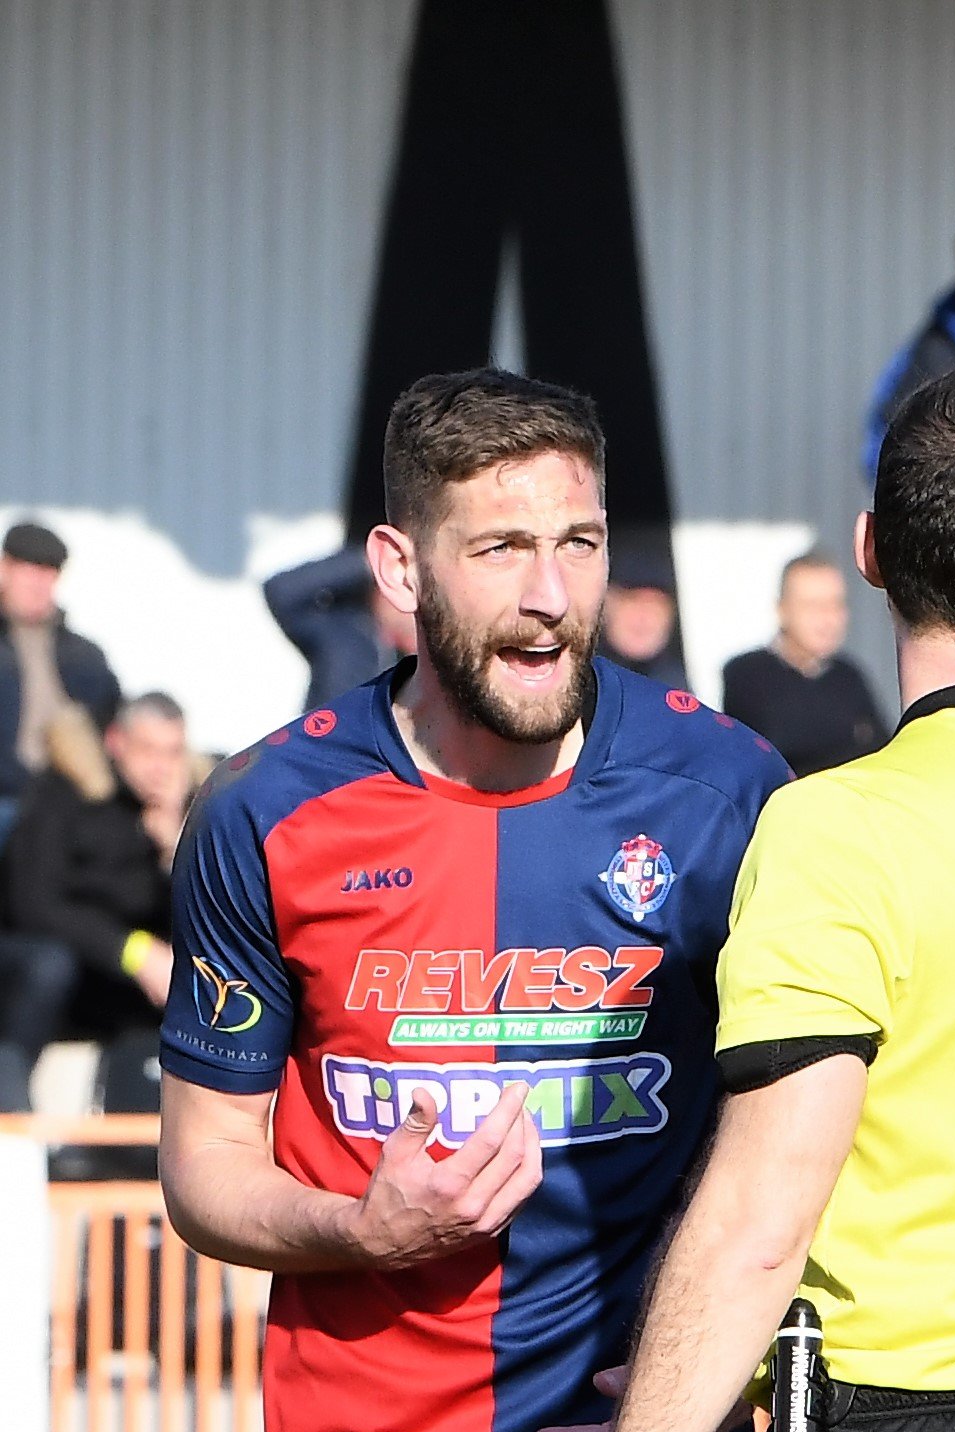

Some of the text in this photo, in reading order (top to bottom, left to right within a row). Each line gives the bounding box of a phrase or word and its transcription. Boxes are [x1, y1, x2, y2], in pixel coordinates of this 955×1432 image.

[340, 867, 414, 892] JAKO
[344, 946, 664, 1013] REVESZ
[396, 1017, 640, 1039] ALWAYS ON THE RIGHT WAY
[791, 1345, 809, 1391] SPRAY
